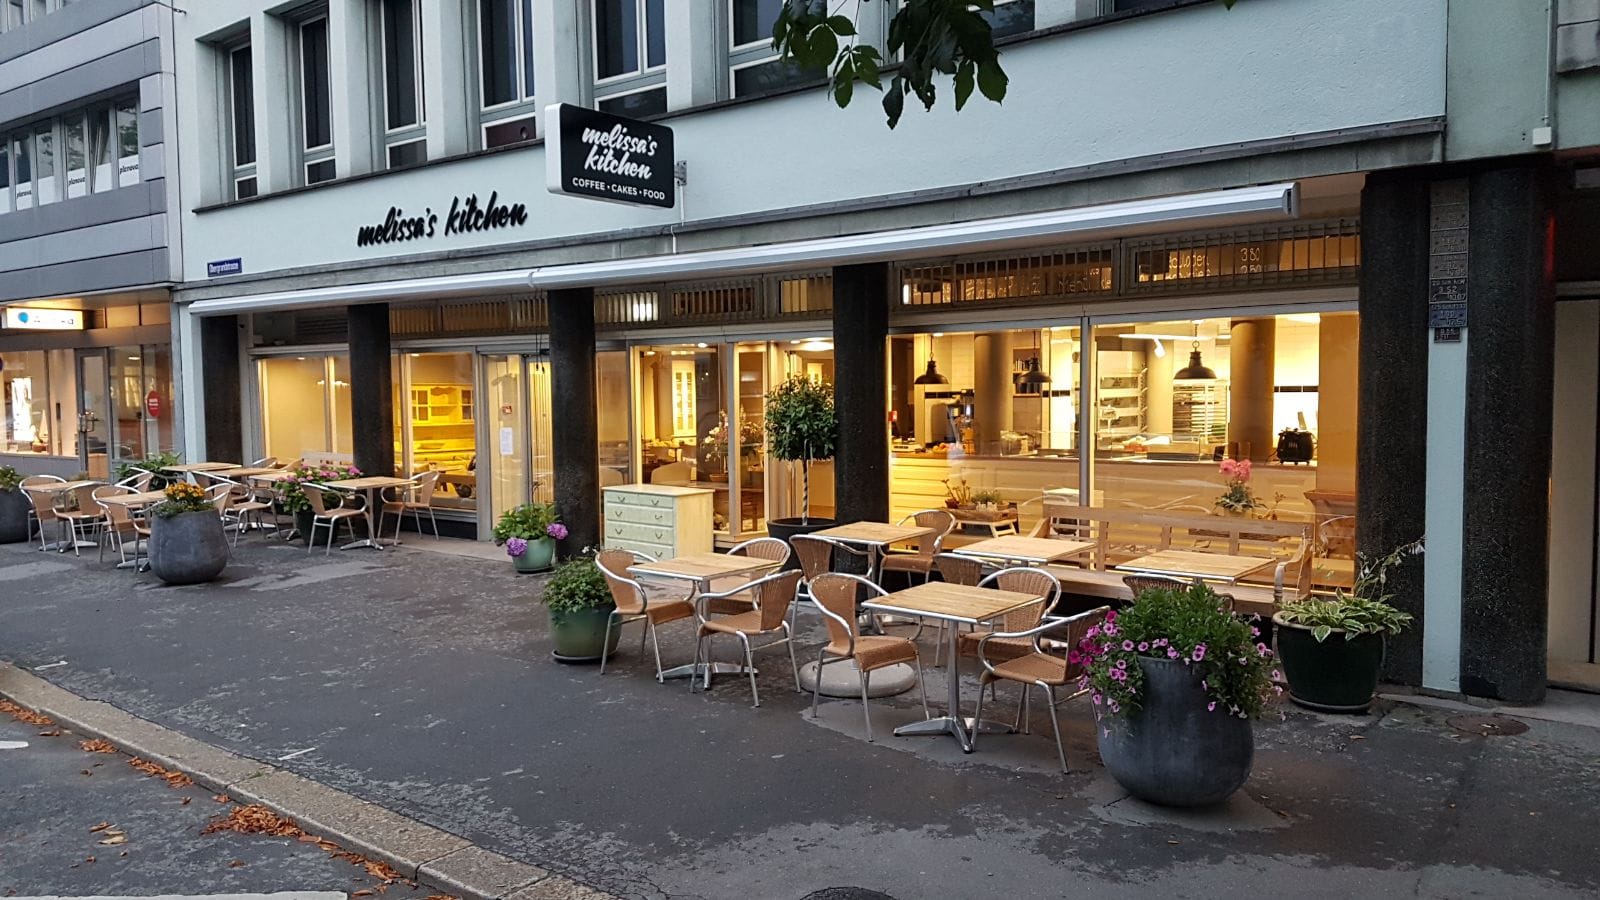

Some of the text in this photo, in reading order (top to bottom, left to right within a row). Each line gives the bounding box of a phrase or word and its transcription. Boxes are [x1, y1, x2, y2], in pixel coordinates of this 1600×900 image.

[582, 123, 658, 157] melissa's
[584, 145, 652, 180] kitchen
[572, 177, 666, 200] COFFEE CAKES FOOD
[357, 190, 528, 247] melissa's kitchen
